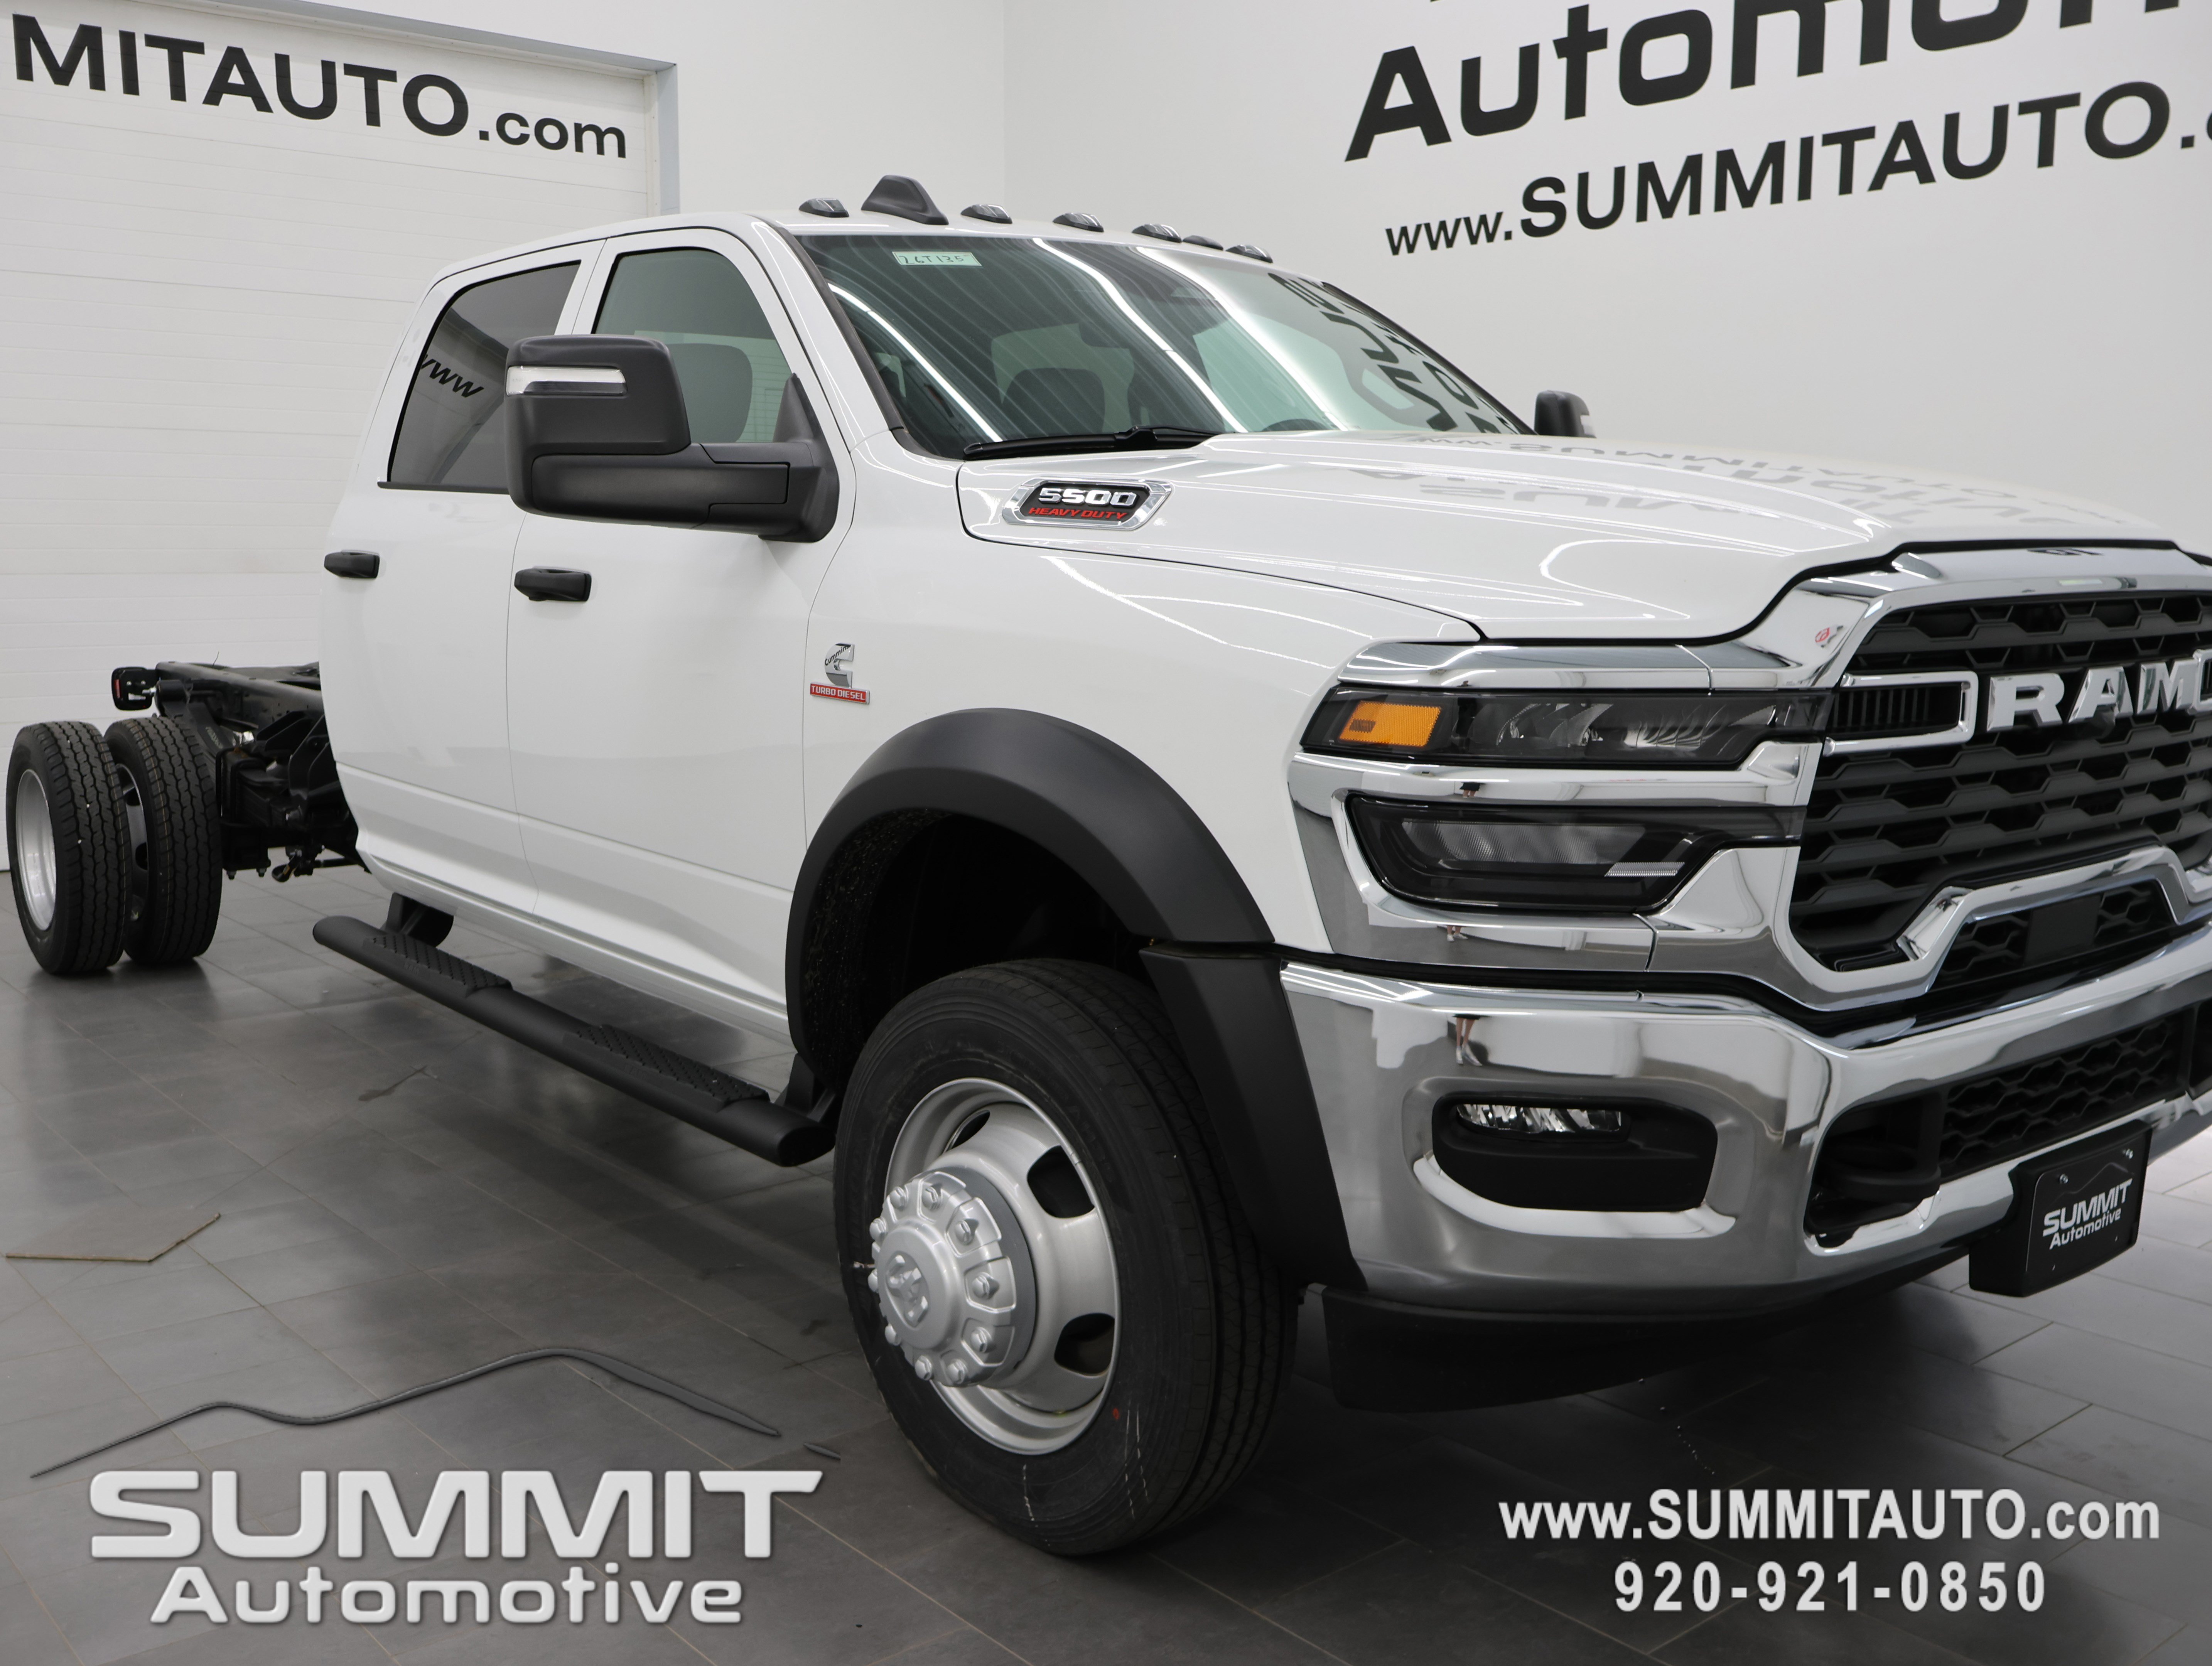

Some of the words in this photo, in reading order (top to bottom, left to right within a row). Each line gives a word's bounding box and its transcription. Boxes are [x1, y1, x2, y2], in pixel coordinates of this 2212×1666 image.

[12, 13, 626, 159] MITAUTO.com
[1385, 81, 2212, 256] www.SUMMITAUTO.
[1029, 507, 1080, 517] HEAVY
[1081, 510, 1127, 519] DUTY
[1039, 487, 1138, 508] 5500
[824, 645, 851, 666] Cummins
[811, 685, 836, 696] TURBO
[837, 690, 865, 700] DIESEL
[1986, 656, 2199, 732] RAM
[2043, 1178, 2133, 1237] SUMMIT
[2049, 1207, 2121, 1250] Automotive
